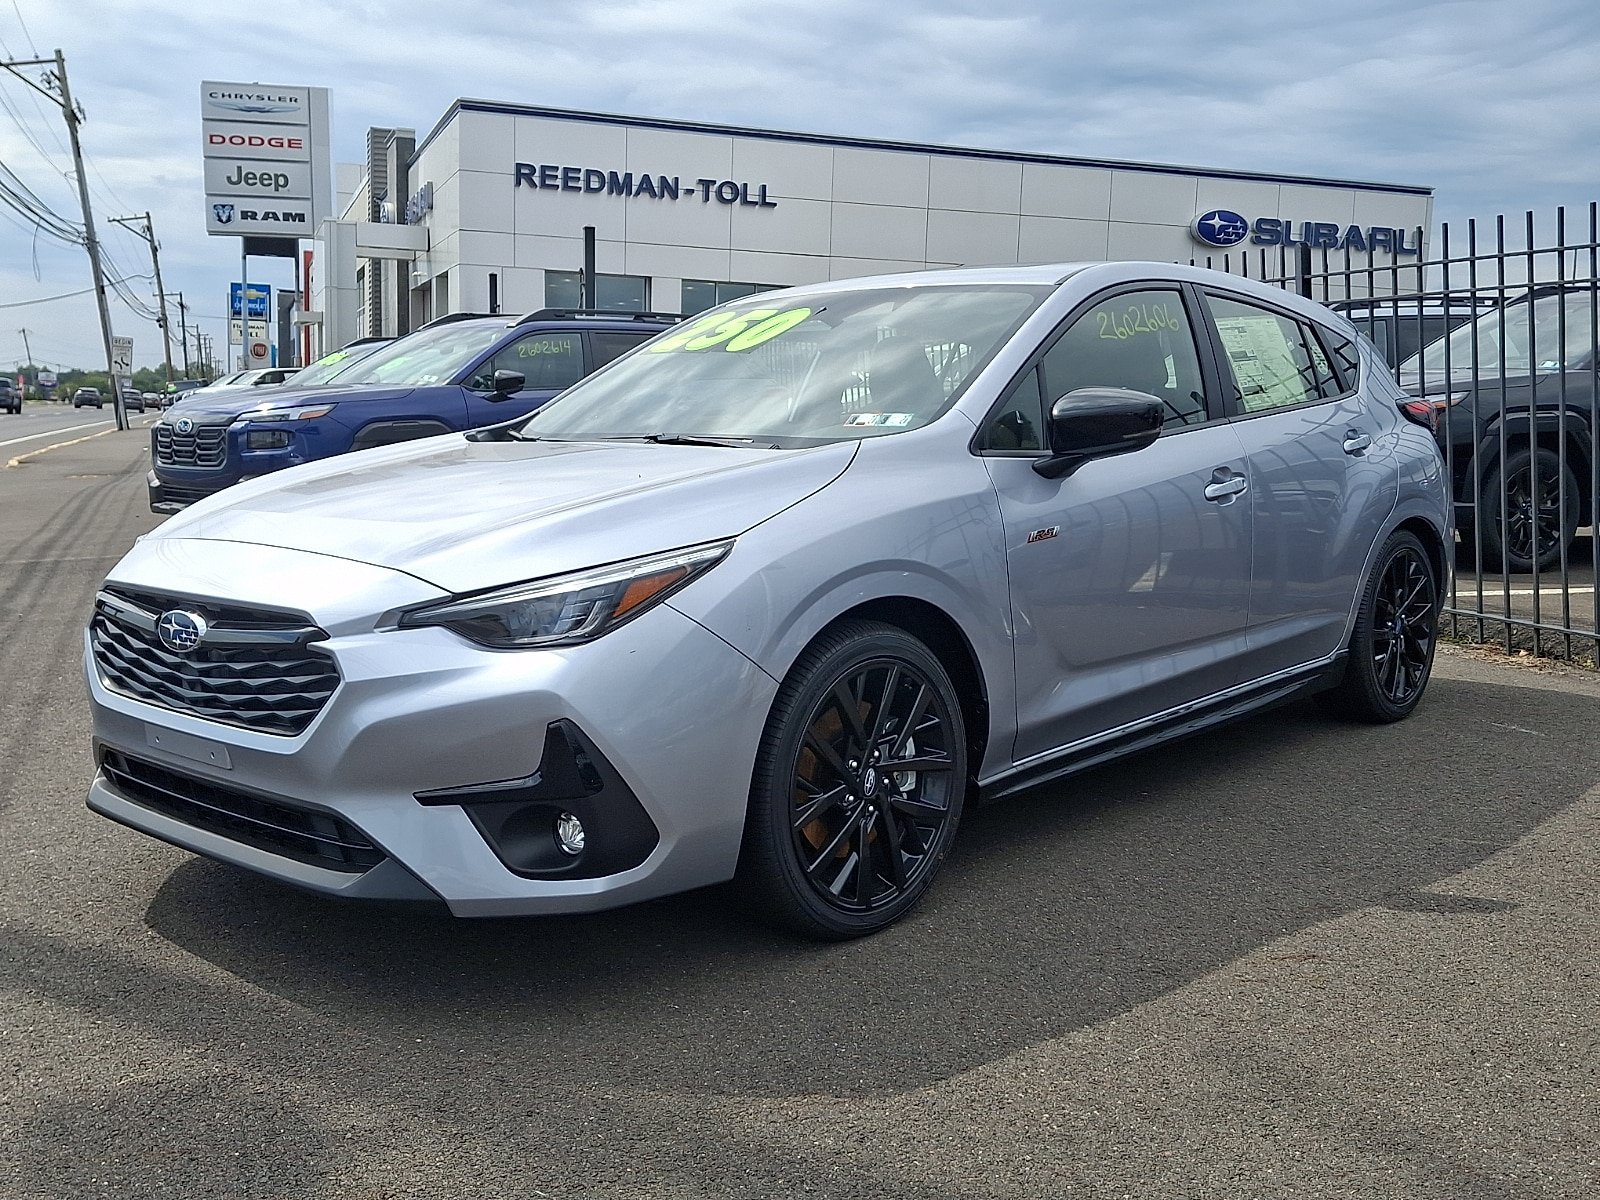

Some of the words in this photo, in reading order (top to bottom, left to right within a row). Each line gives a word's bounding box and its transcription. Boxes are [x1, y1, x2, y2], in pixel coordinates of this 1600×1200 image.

[209, 91, 299, 103] CHRYSLER
[209, 134, 303, 149] DODGE
[226, 165, 289, 192] Jeep
[514, 162, 778, 209] REEDMAN-TOLL
[240, 210, 306, 223] RAM
[1252, 217, 1419, 255] SUBARU
[1096, 303, 1180, 340] 2602606
[518, 339, 571, 358] 2602614
